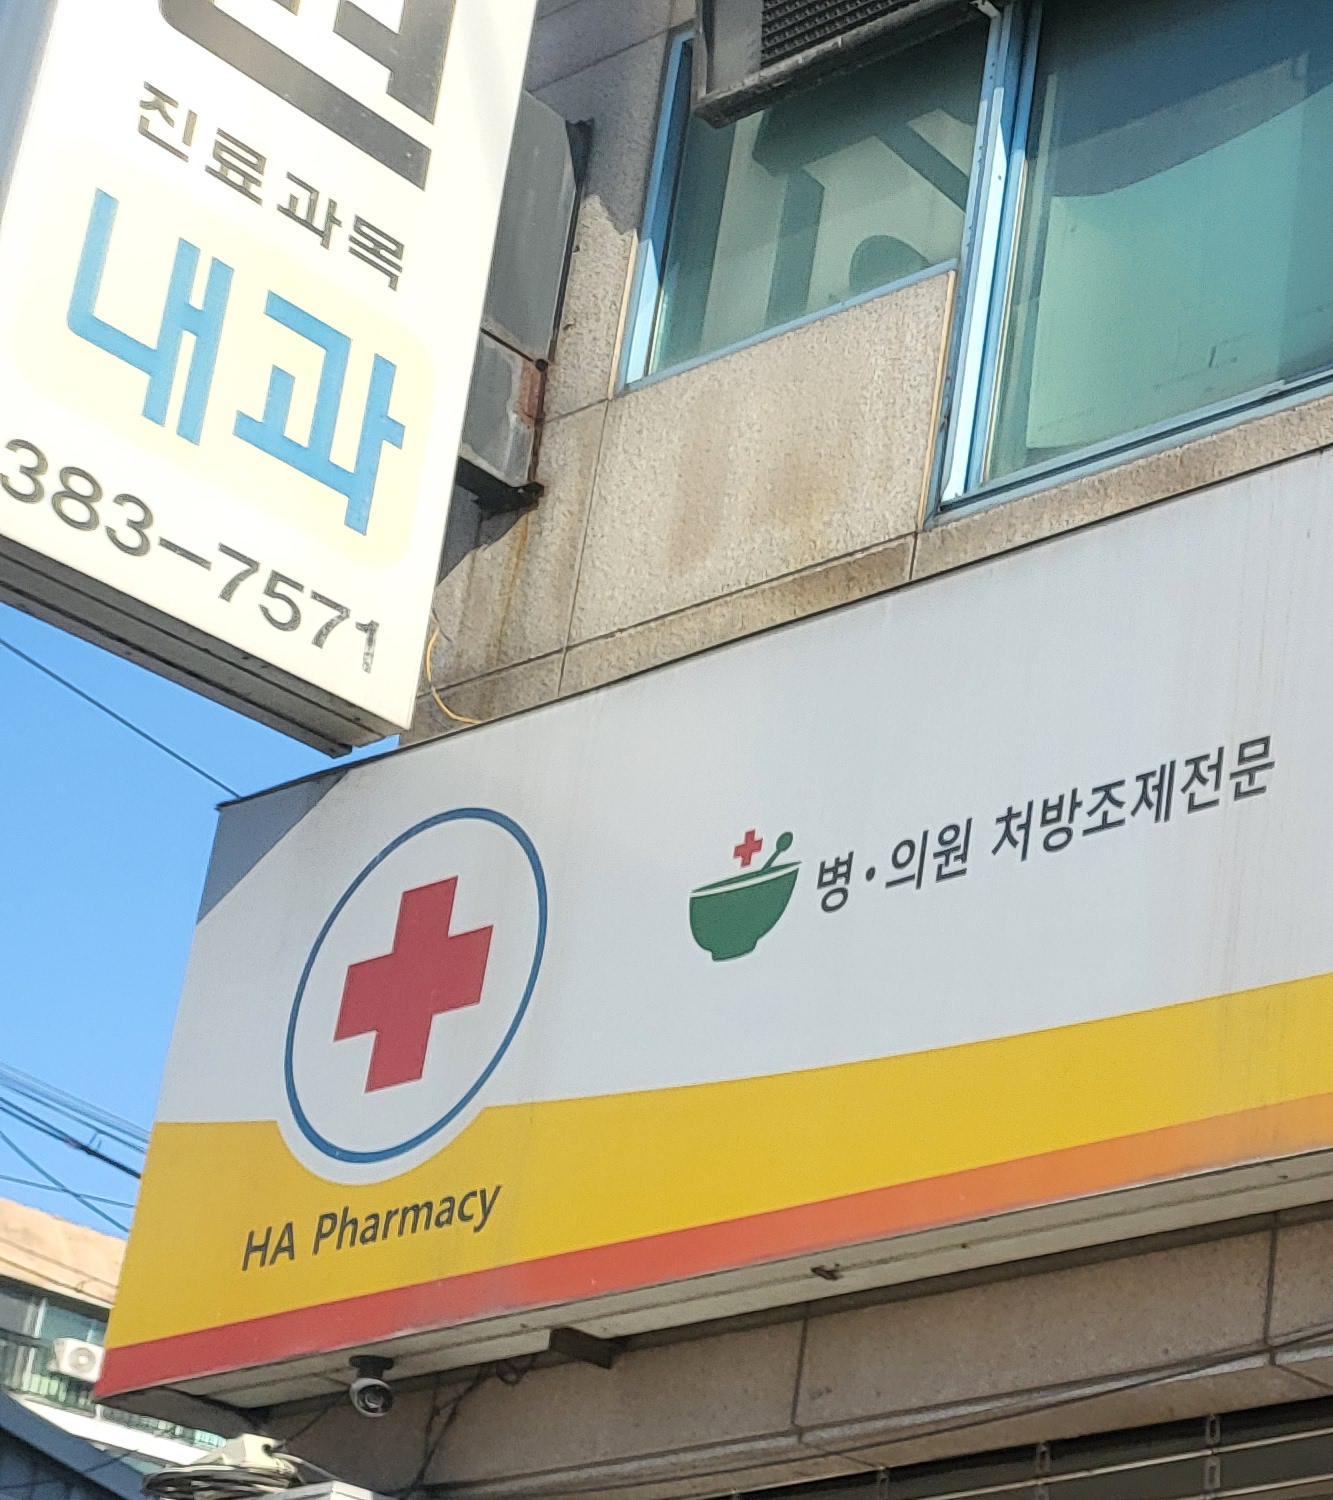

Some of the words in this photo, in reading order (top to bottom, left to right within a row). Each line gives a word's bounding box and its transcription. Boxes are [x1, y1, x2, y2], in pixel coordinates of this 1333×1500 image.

[137, 81, 406, 291] 진료과목
[67, 188, 406, 536] 내과
[0, 438, 381, 674] 383-7571
[991, 735, 1276, 863] 처방조제전문
[241, 1226, 296, 1271] HA
[312, 1182, 502, 1257] Pharmacy
